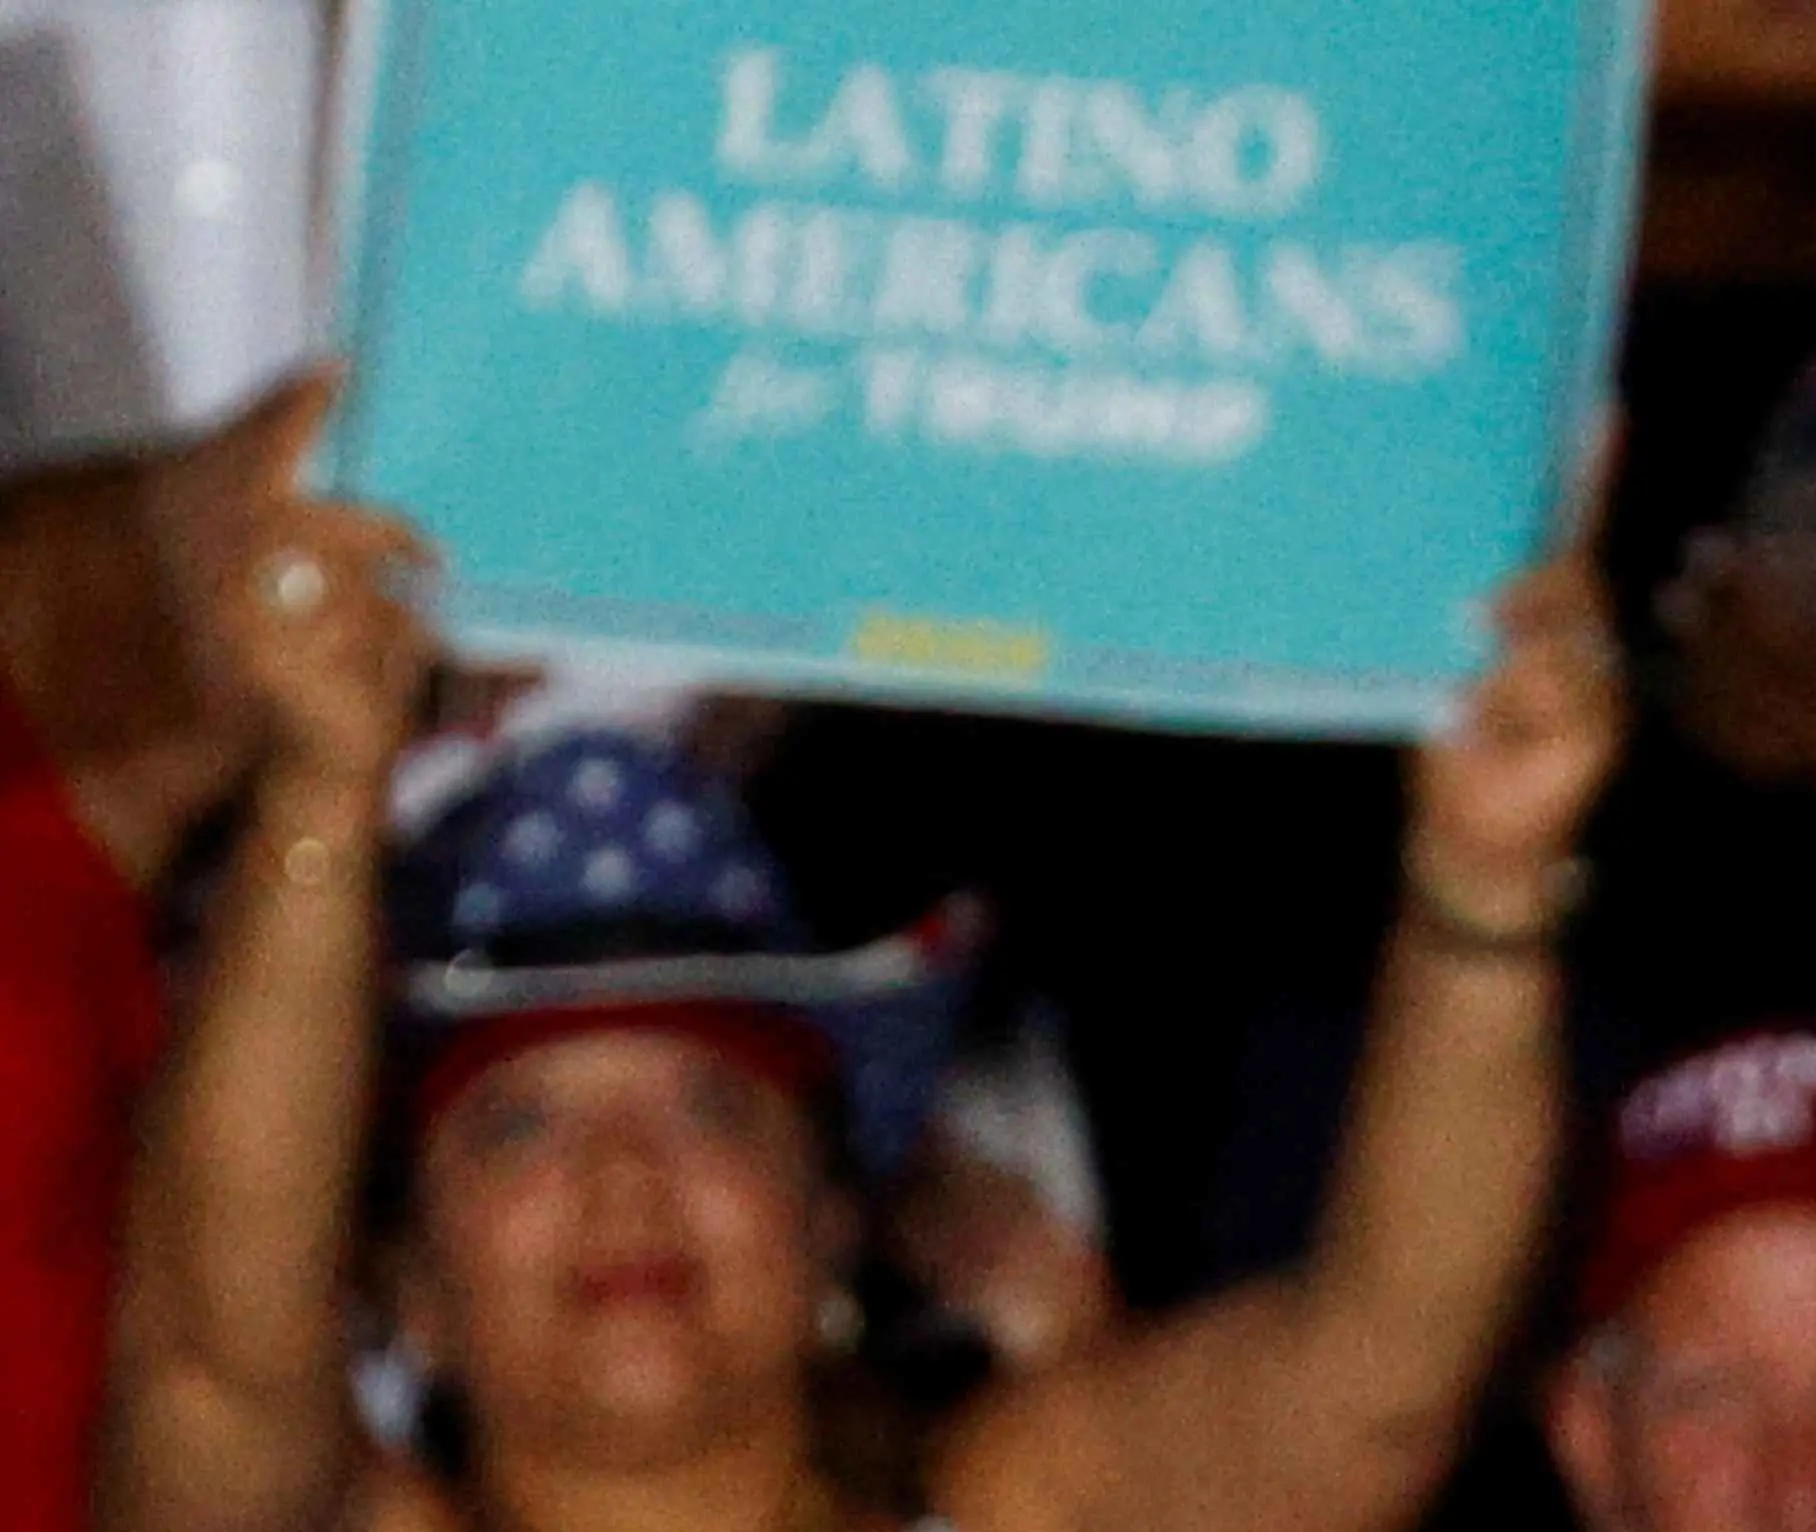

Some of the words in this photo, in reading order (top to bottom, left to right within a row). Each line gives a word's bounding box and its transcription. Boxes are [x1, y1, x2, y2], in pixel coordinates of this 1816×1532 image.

[714, 42, 1328, 220] LATINO
[520, 182, 1464, 374] AMERICANS
[862, 350, 1268, 464] TRUMP
